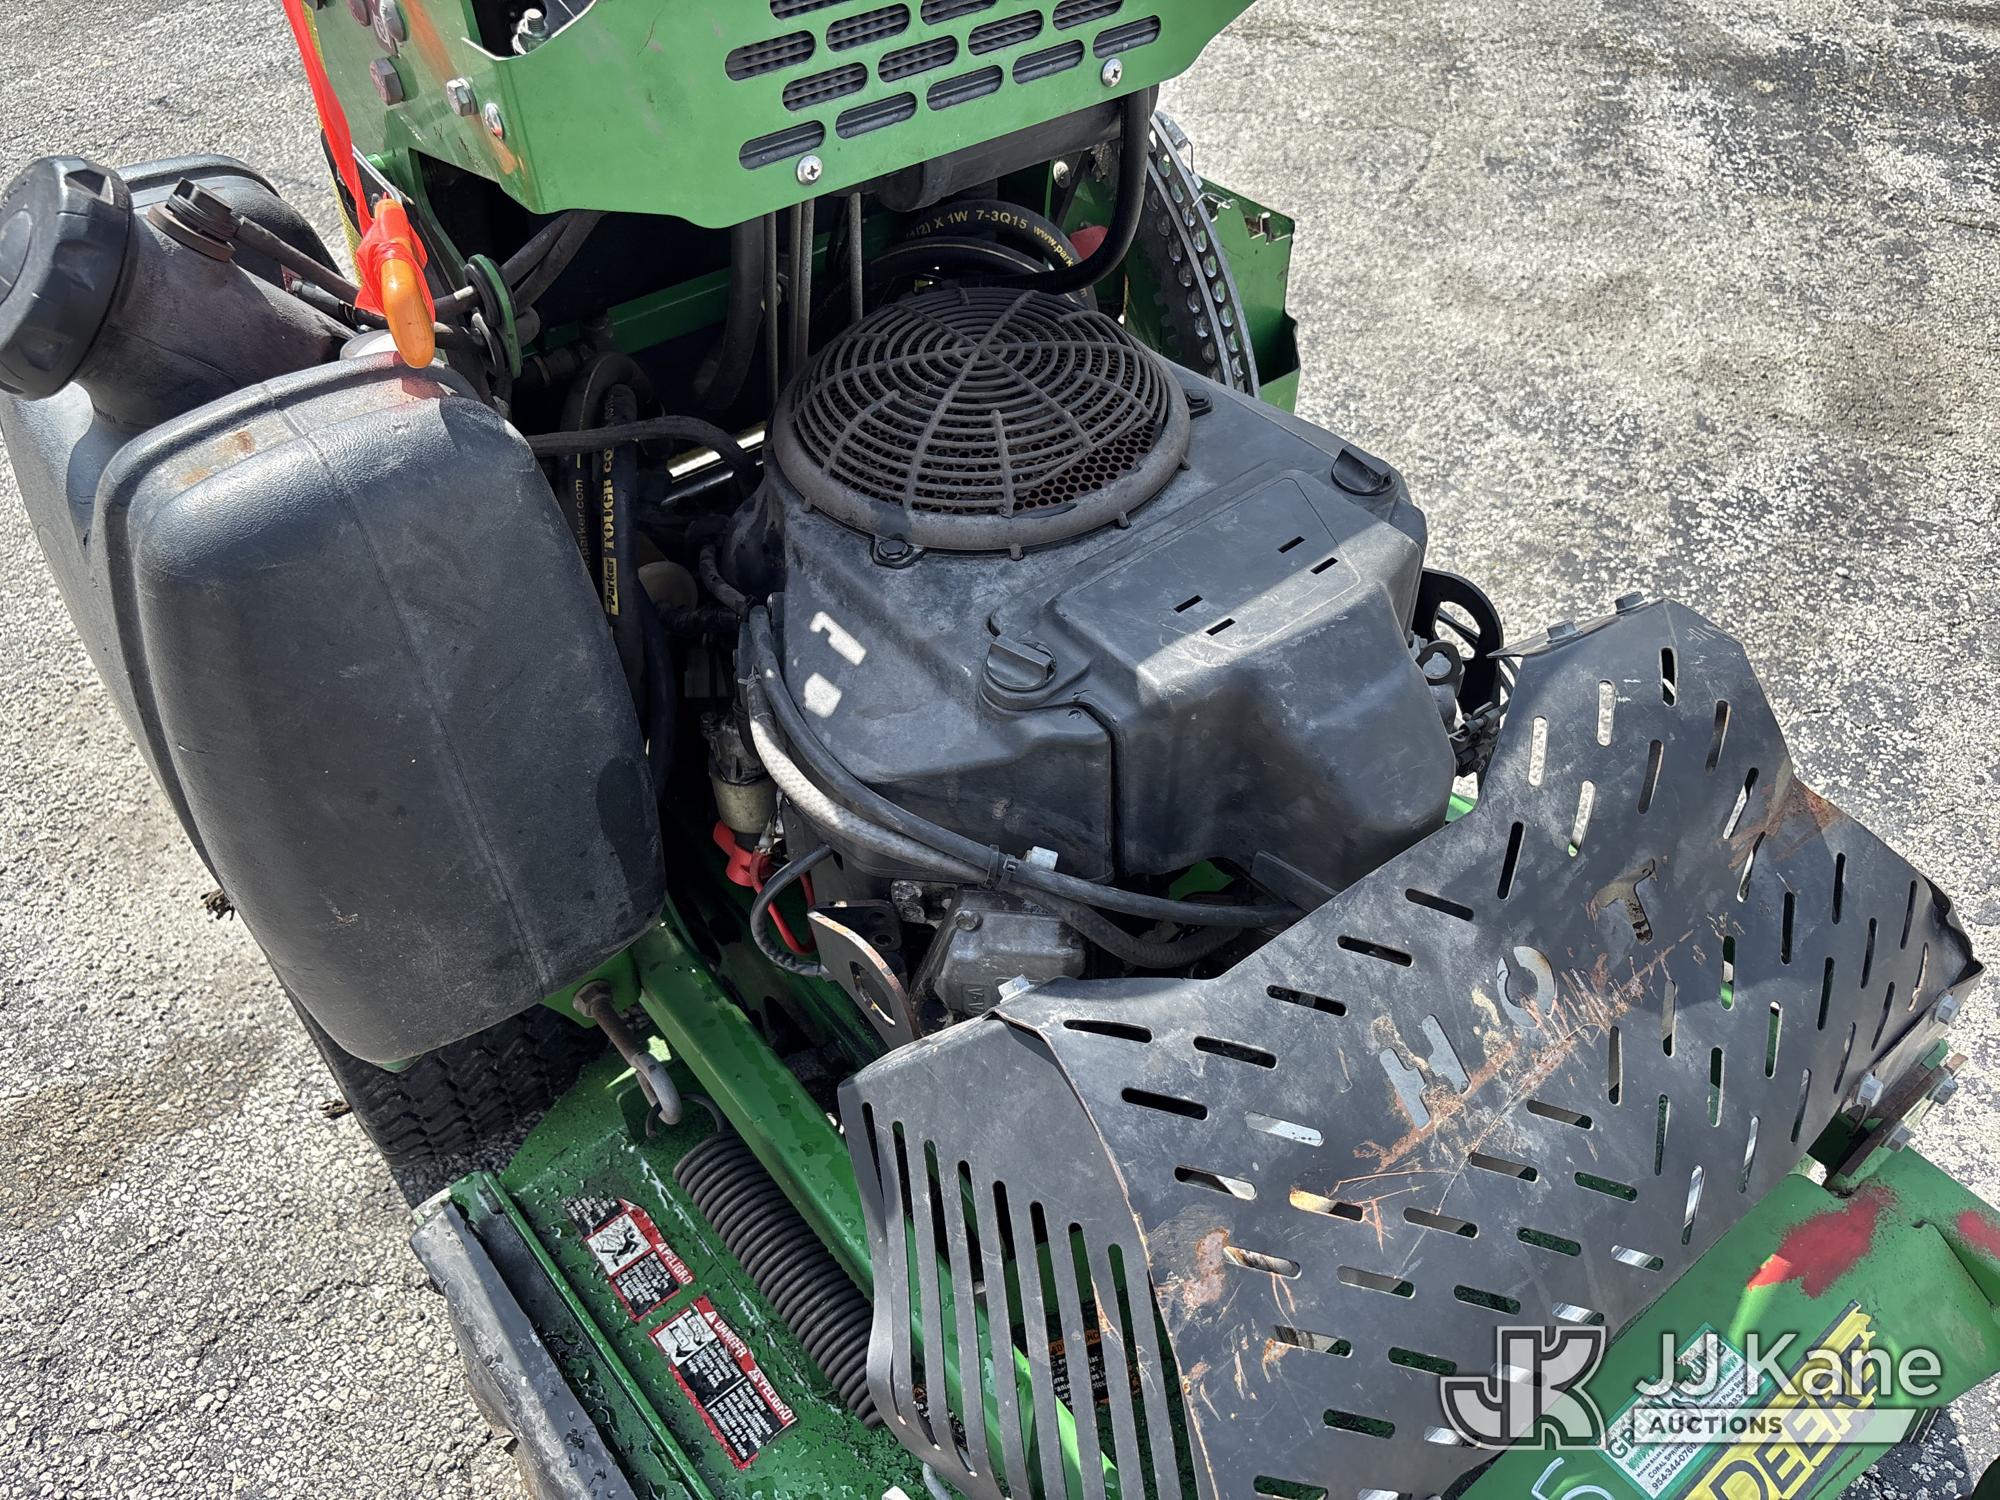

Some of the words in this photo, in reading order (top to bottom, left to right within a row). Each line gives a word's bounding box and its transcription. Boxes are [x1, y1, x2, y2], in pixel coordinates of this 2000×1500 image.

[933, 217, 944, 229] X
[947, 210, 968, 224] 1W
[976, 209, 1029, 229] 7-3Q15
[1033, 225, 1073, 267] www.park
[602, 479, 616, 552] TOUGH
[604, 558, 618, 612] Parker
[661, 1247, 693, 1285] PELIGRO
[705, 1372, 720, 1388] deck
[713, 1356, 733, 1379] rotating
[713, 1318, 748, 1358] DANGER
[757, 1378, 793, 1421] PELIGRO
[728, 1391, 740, 1403] por
[736, 1400, 747, 1411] las
[742, 1380, 756, 1396] Para
[751, 1394, 767, 1412] evitar
[1708, 1331, 1873, 1500] DEERE
[715, 1400, 727, 1412] del
[734, 1426, 744, 1436] de
[739, 1433, 748, 1442] la
[729, 1433, 739, 1443] de
[751, 1408, 774, 1435] causadas
[1650, 1441, 1699, 1490] 954-344-0760
